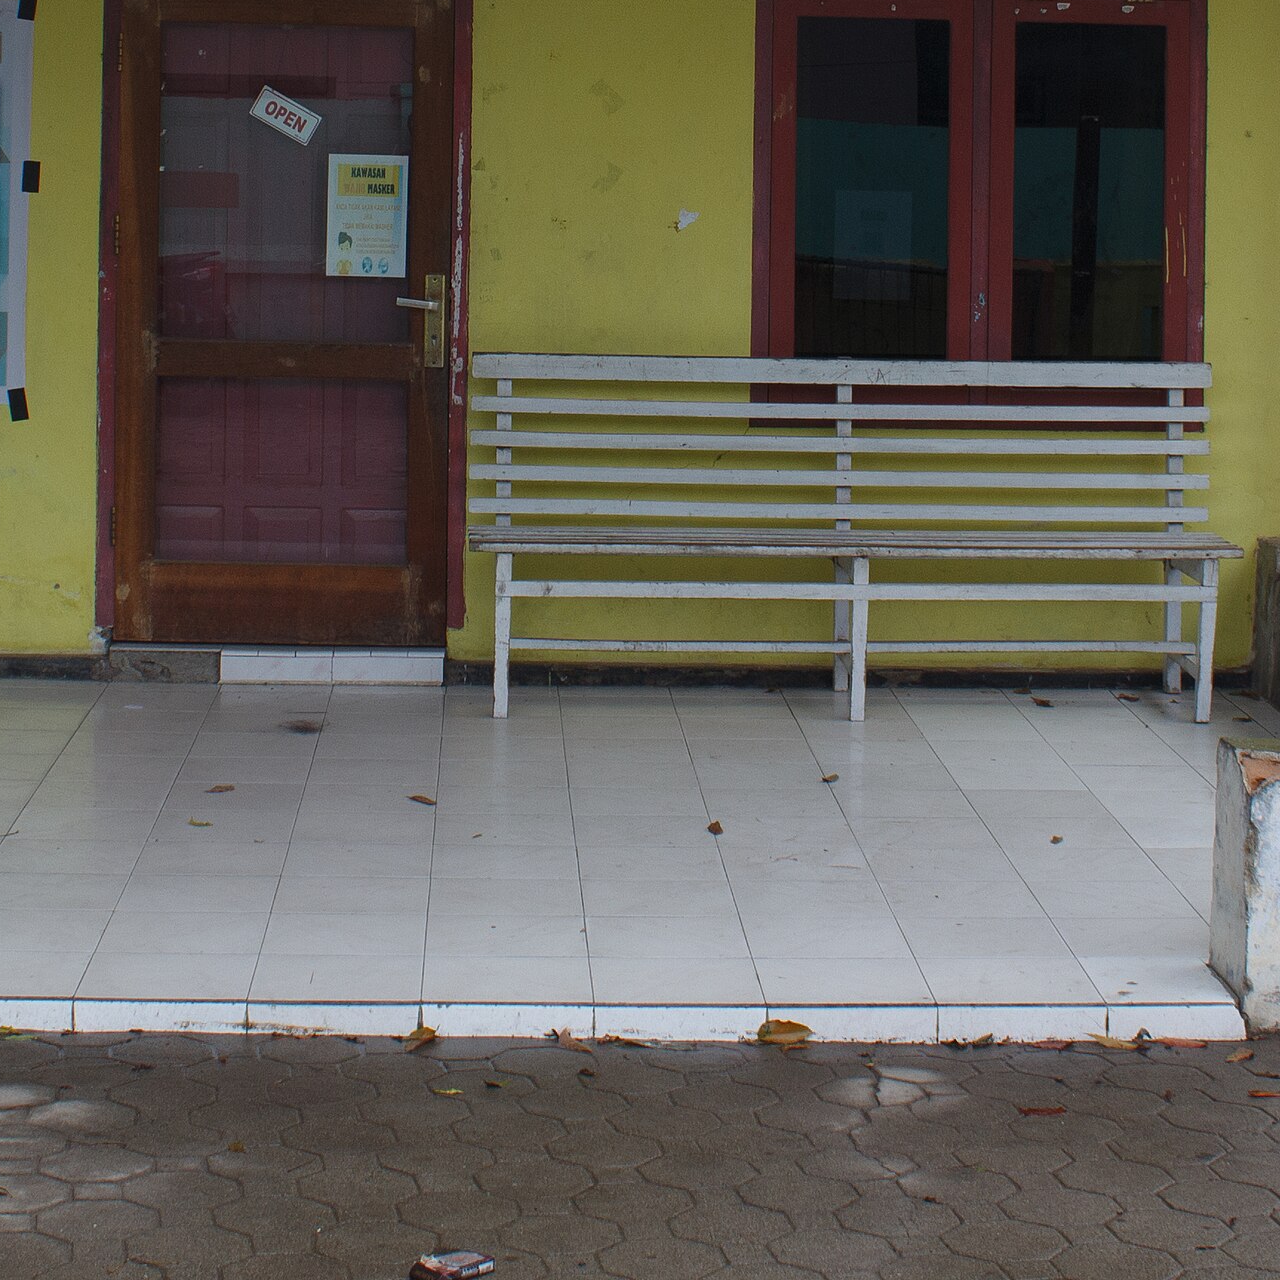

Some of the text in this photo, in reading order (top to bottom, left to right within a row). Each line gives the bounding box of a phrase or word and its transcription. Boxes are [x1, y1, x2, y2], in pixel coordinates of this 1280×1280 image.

[265, 101, 308, 133] OPEN
[351, 167, 386, 179] KAWASAN
[367, 183, 395, 194] MASKER
